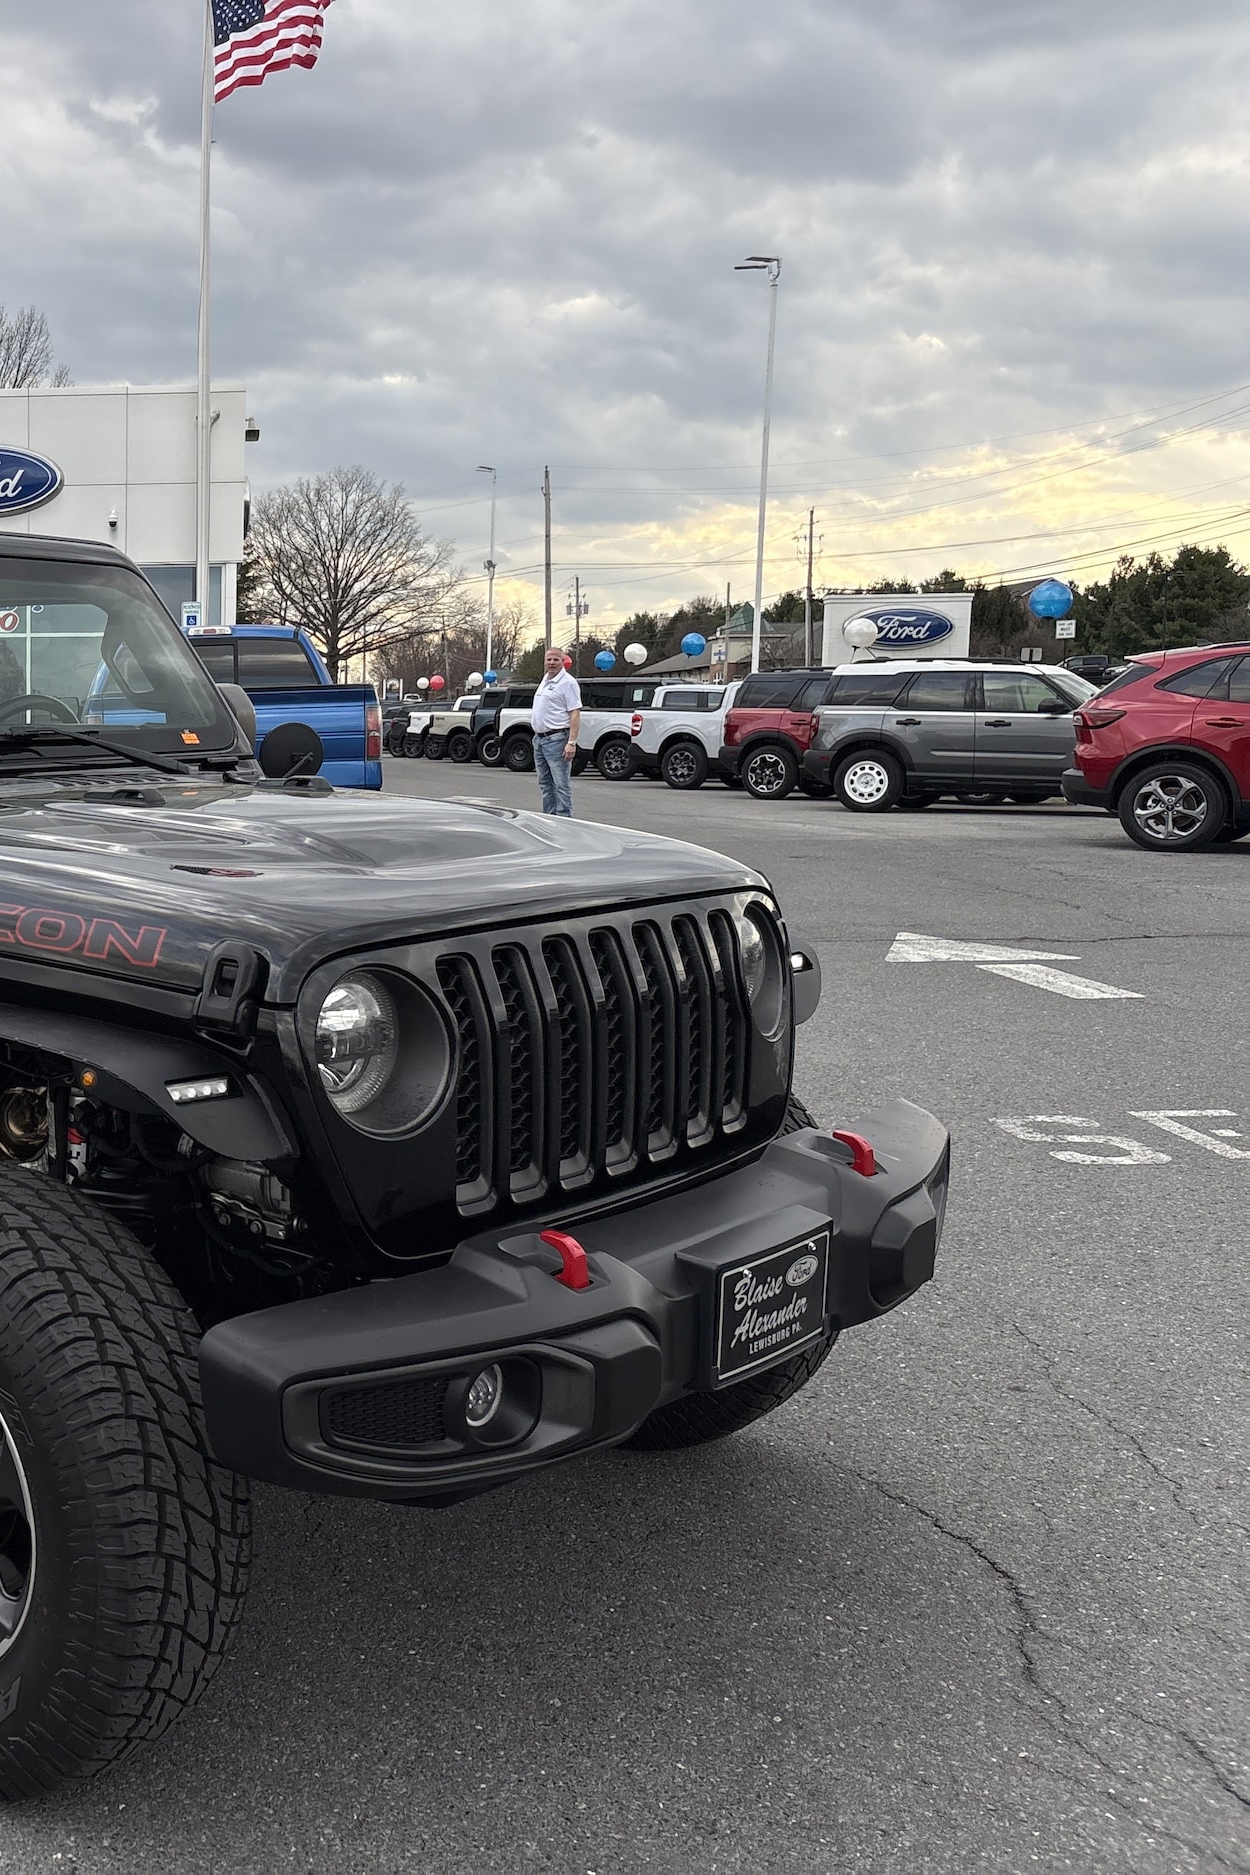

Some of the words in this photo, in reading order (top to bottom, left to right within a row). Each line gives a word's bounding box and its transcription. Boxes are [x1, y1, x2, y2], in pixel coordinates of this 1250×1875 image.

[876, 615, 932, 639] Ford
[791, 1261, 813, 1282] Ford
[734, 1275, 784, 1311] Blaise
[730, 1292, 808, 1348] Alexander
[749, 1326, 791, 1354] LEWISBURG
